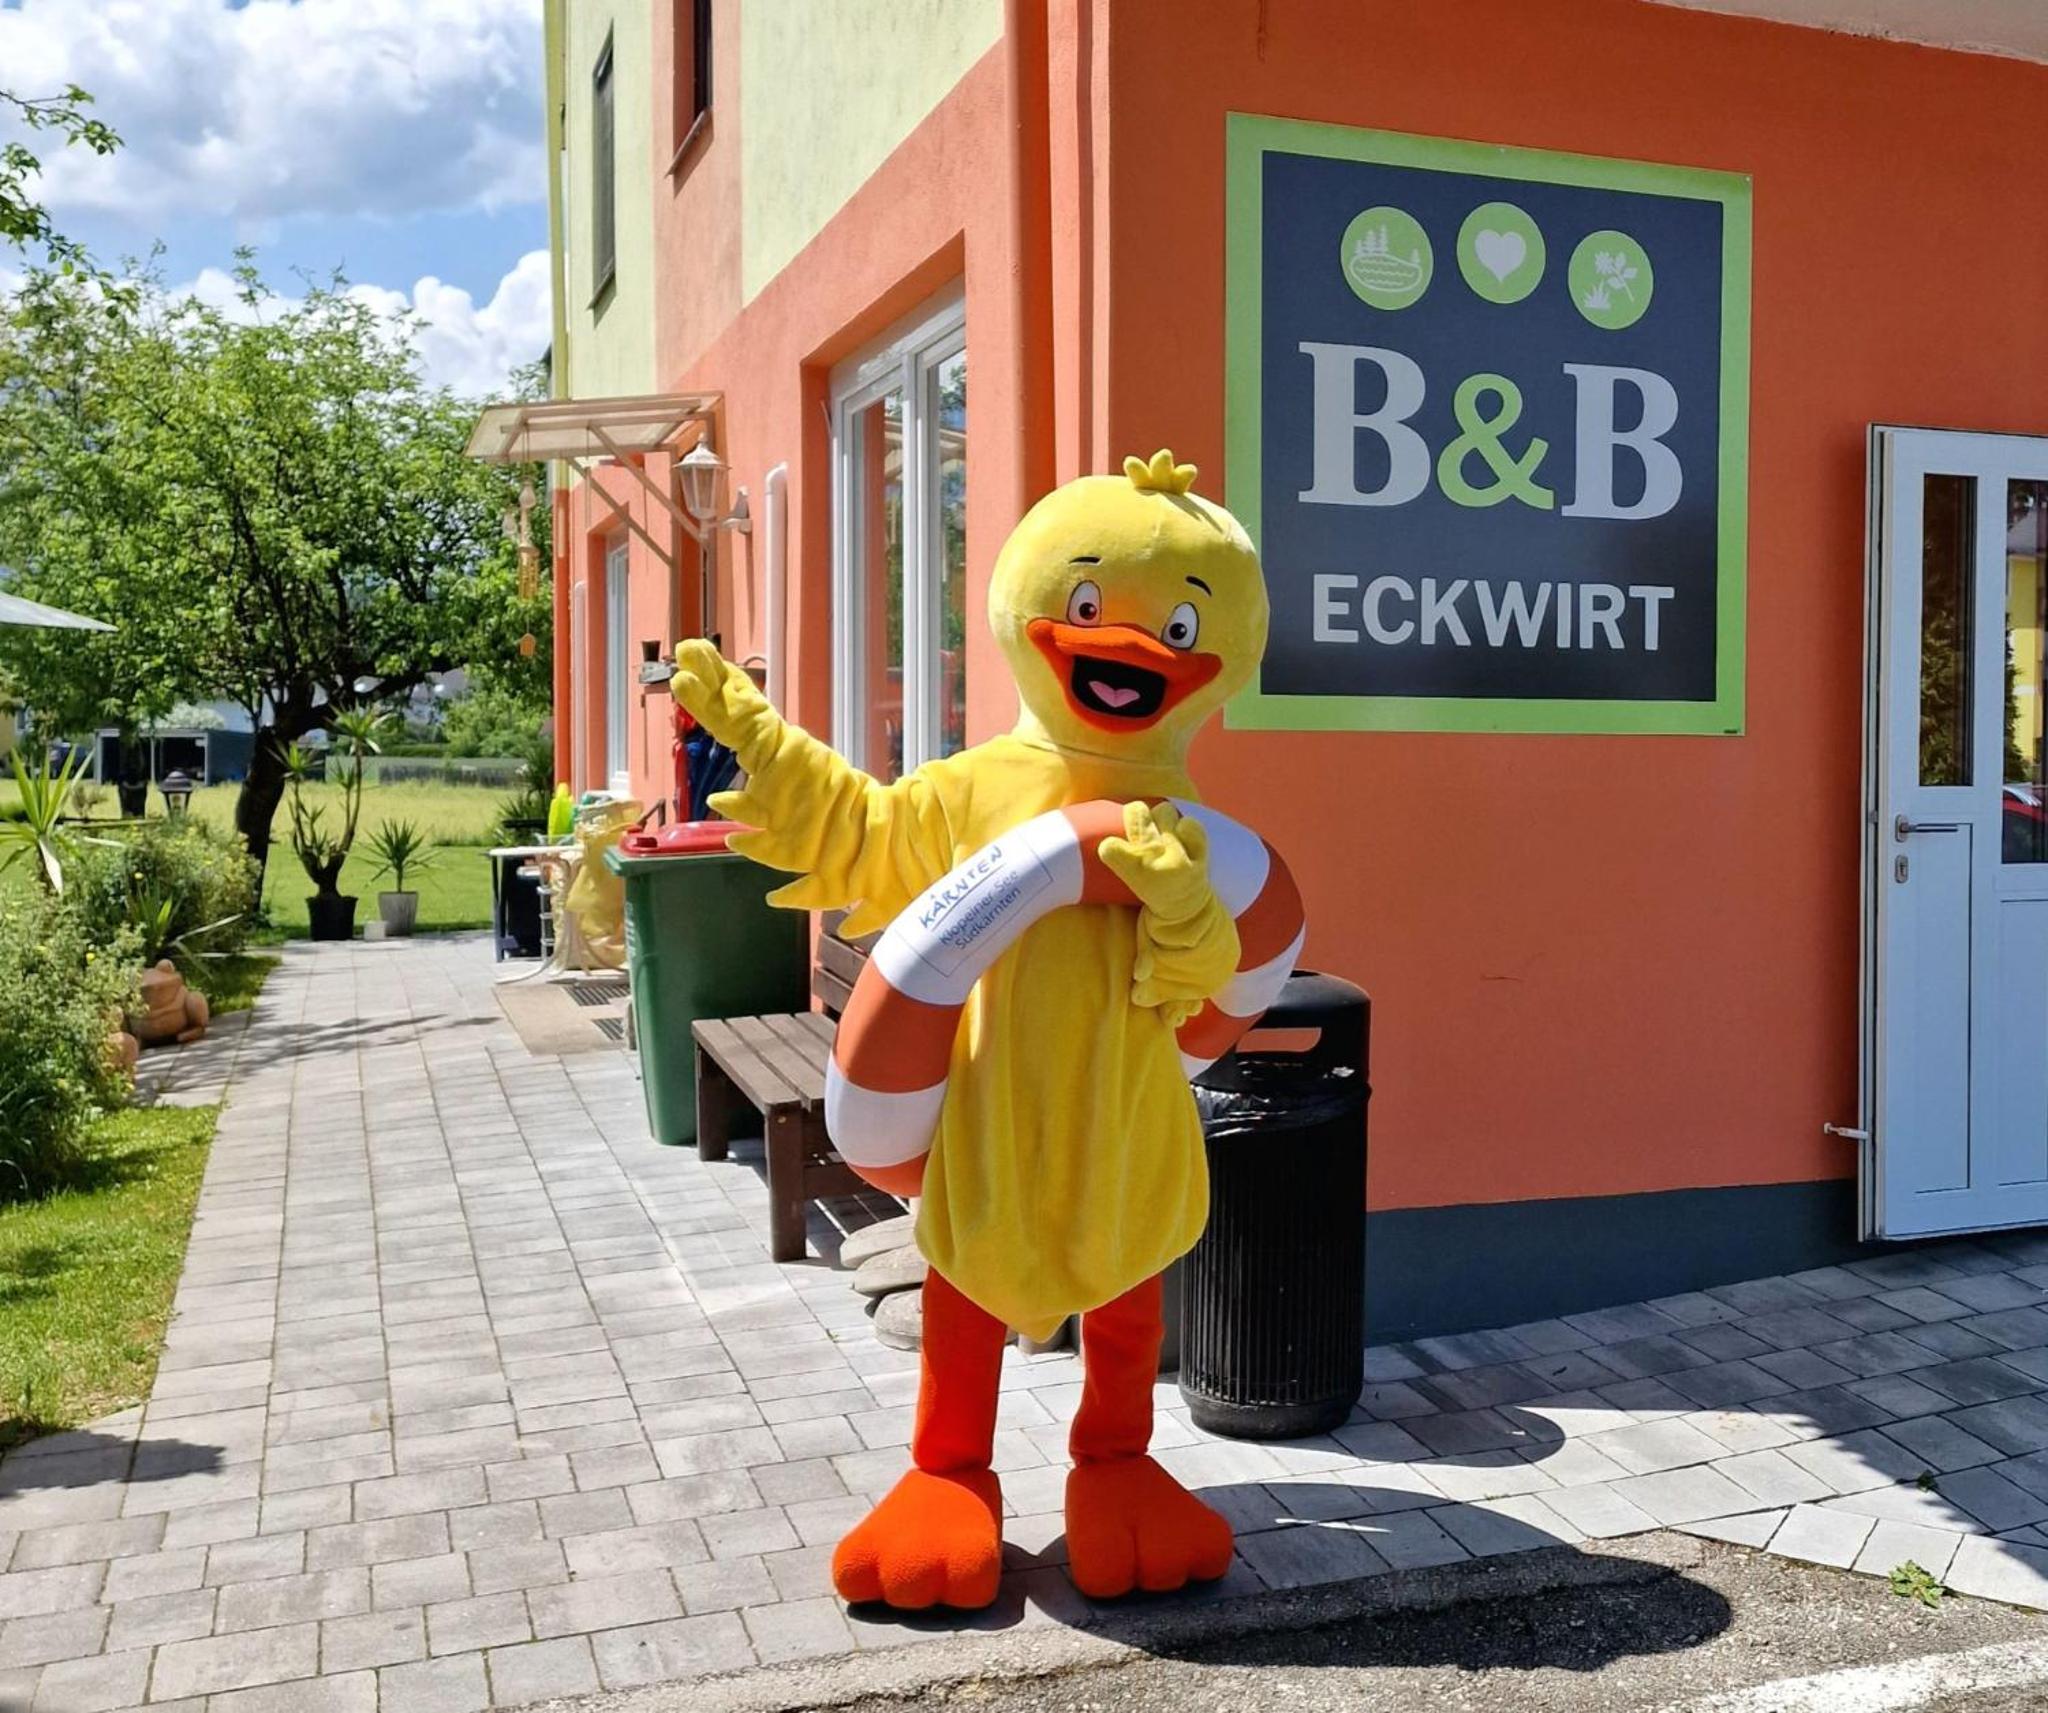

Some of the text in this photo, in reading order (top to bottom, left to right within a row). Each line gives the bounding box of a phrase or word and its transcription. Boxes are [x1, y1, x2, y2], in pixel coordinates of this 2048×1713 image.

[1298, 341, 1684, 521] B&B
[1313, 573, 1676, 652] ECKWIRT
[939, 870, 1019, 945] Klopeiner See
